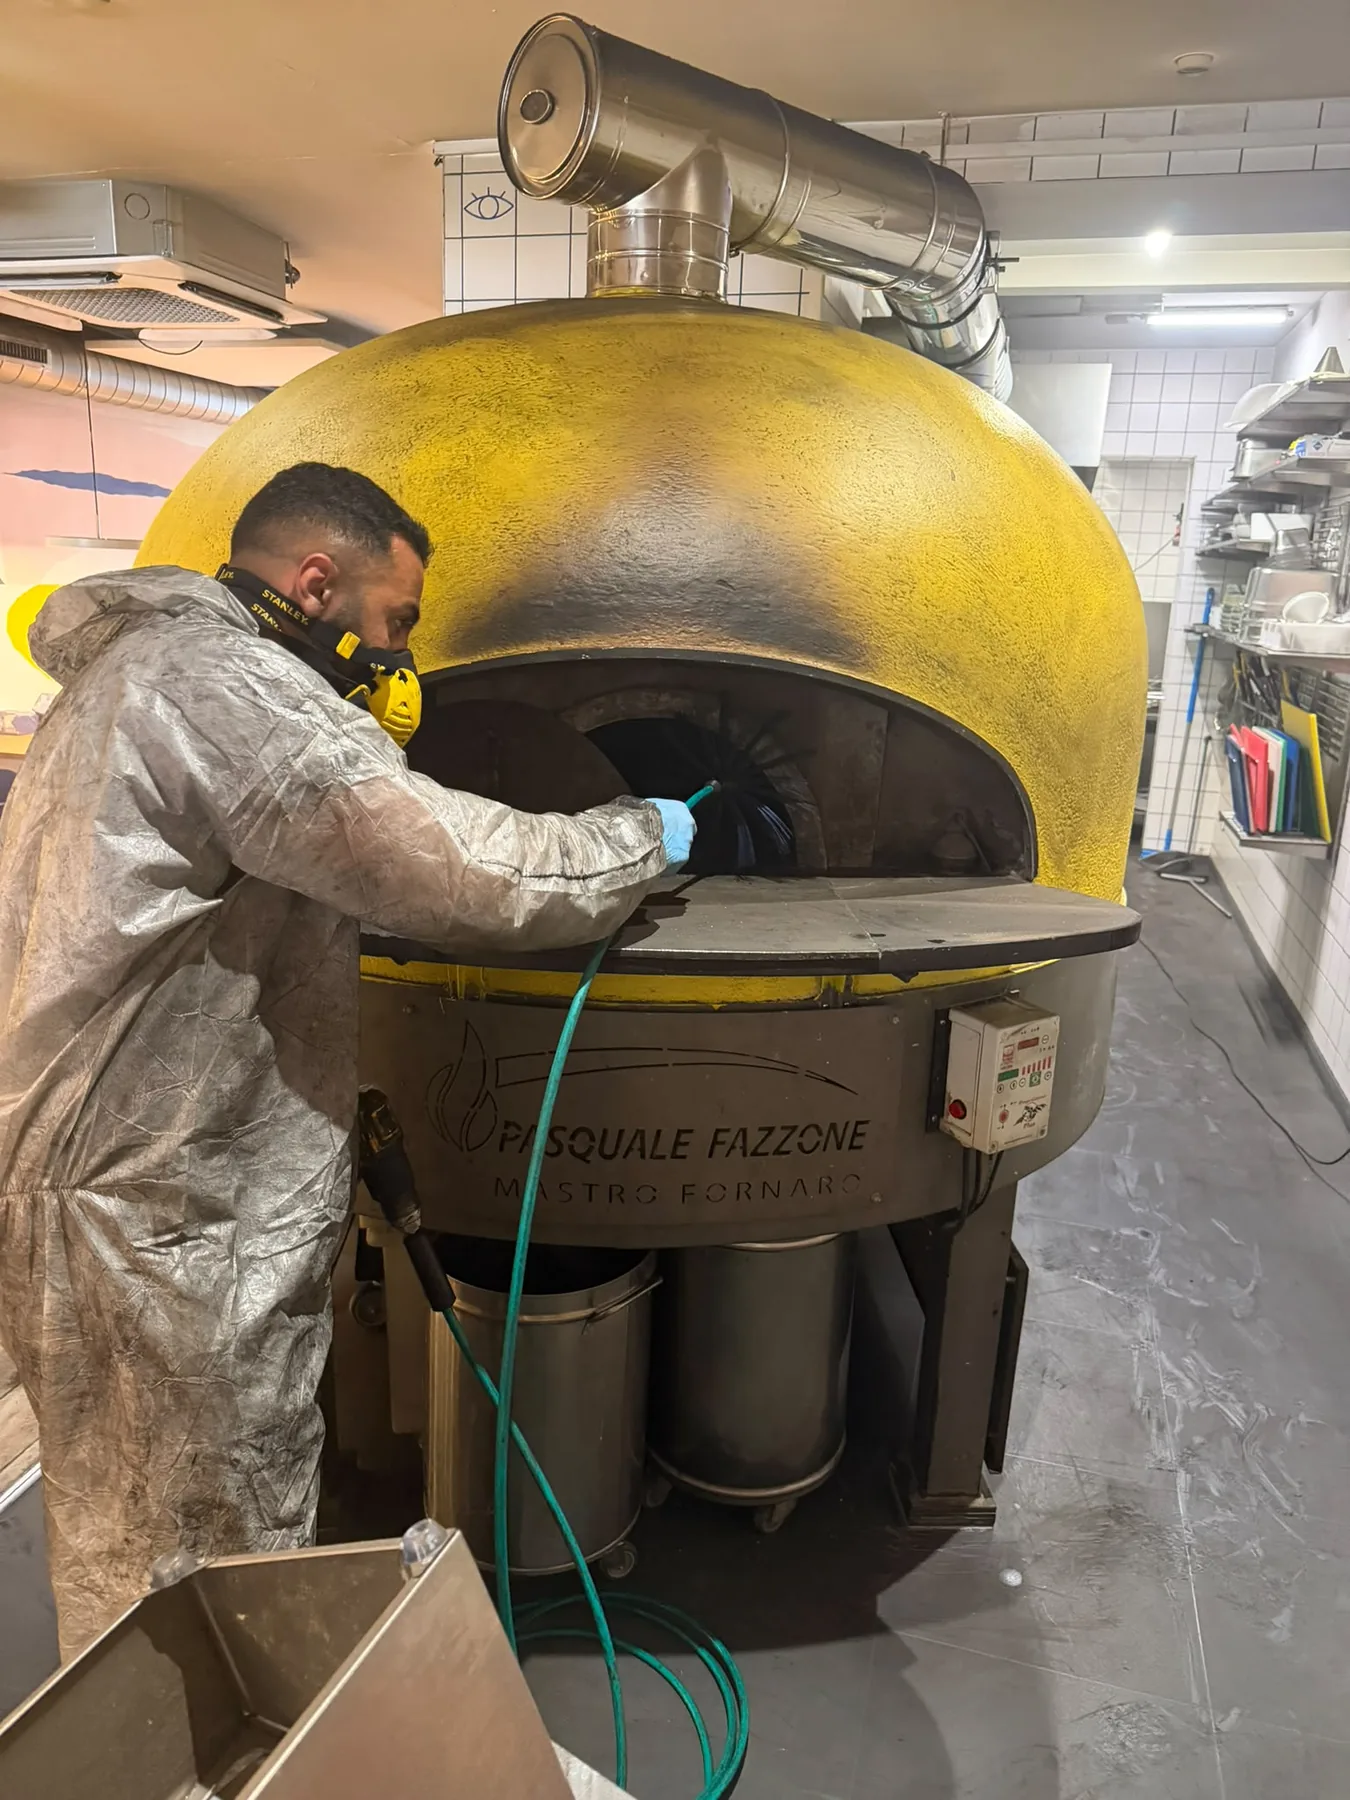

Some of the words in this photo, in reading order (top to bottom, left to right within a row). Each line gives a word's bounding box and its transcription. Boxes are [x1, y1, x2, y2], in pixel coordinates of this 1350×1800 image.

[262, 589, 308, 625] STANLEY
[499, 1120, 694, 1164] PASQUALE
[707, 1119, 871, 1159] FAZZONE
[681, 1173, 861, 1204] FORNARO
